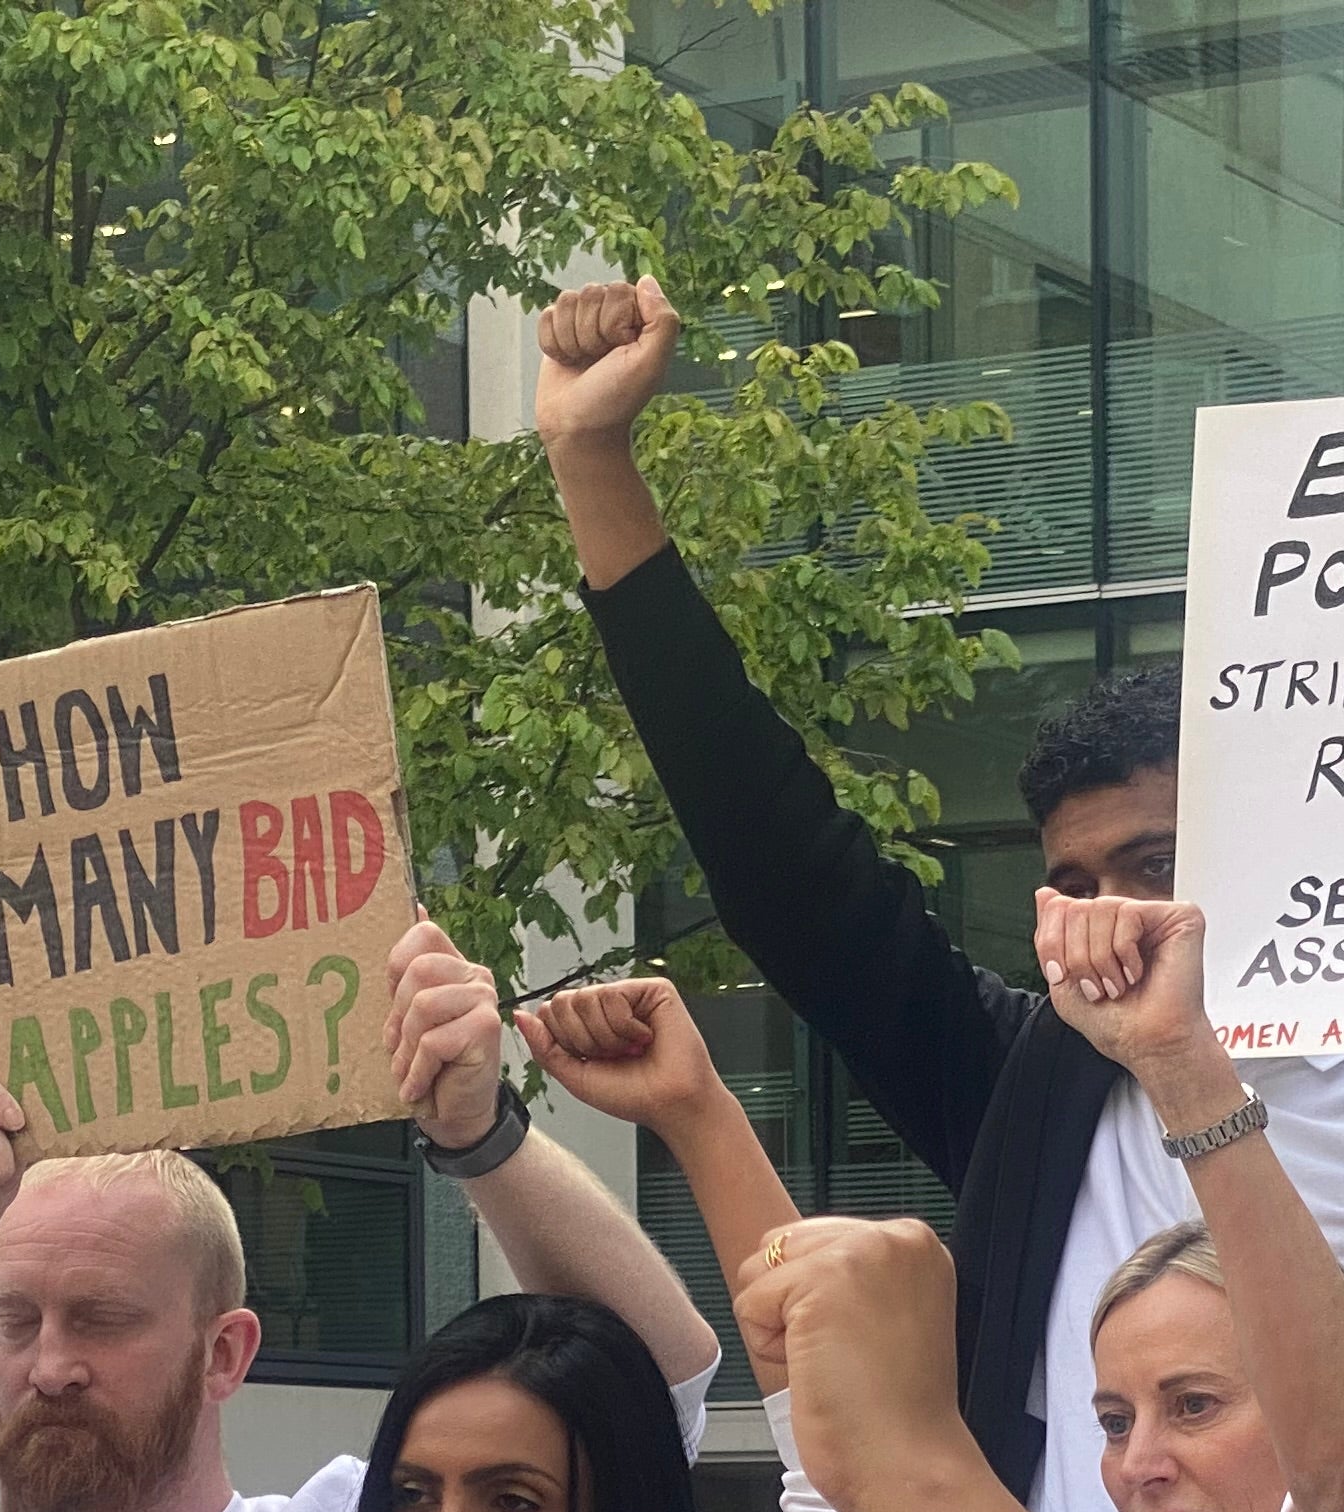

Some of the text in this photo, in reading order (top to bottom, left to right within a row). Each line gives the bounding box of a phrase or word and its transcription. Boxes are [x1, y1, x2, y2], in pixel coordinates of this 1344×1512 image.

[239, 790, 385, 939] BAD
[6, 954, 360, 1132] APPLES?
[1215, 1022, 1299, 1049] OMEN
